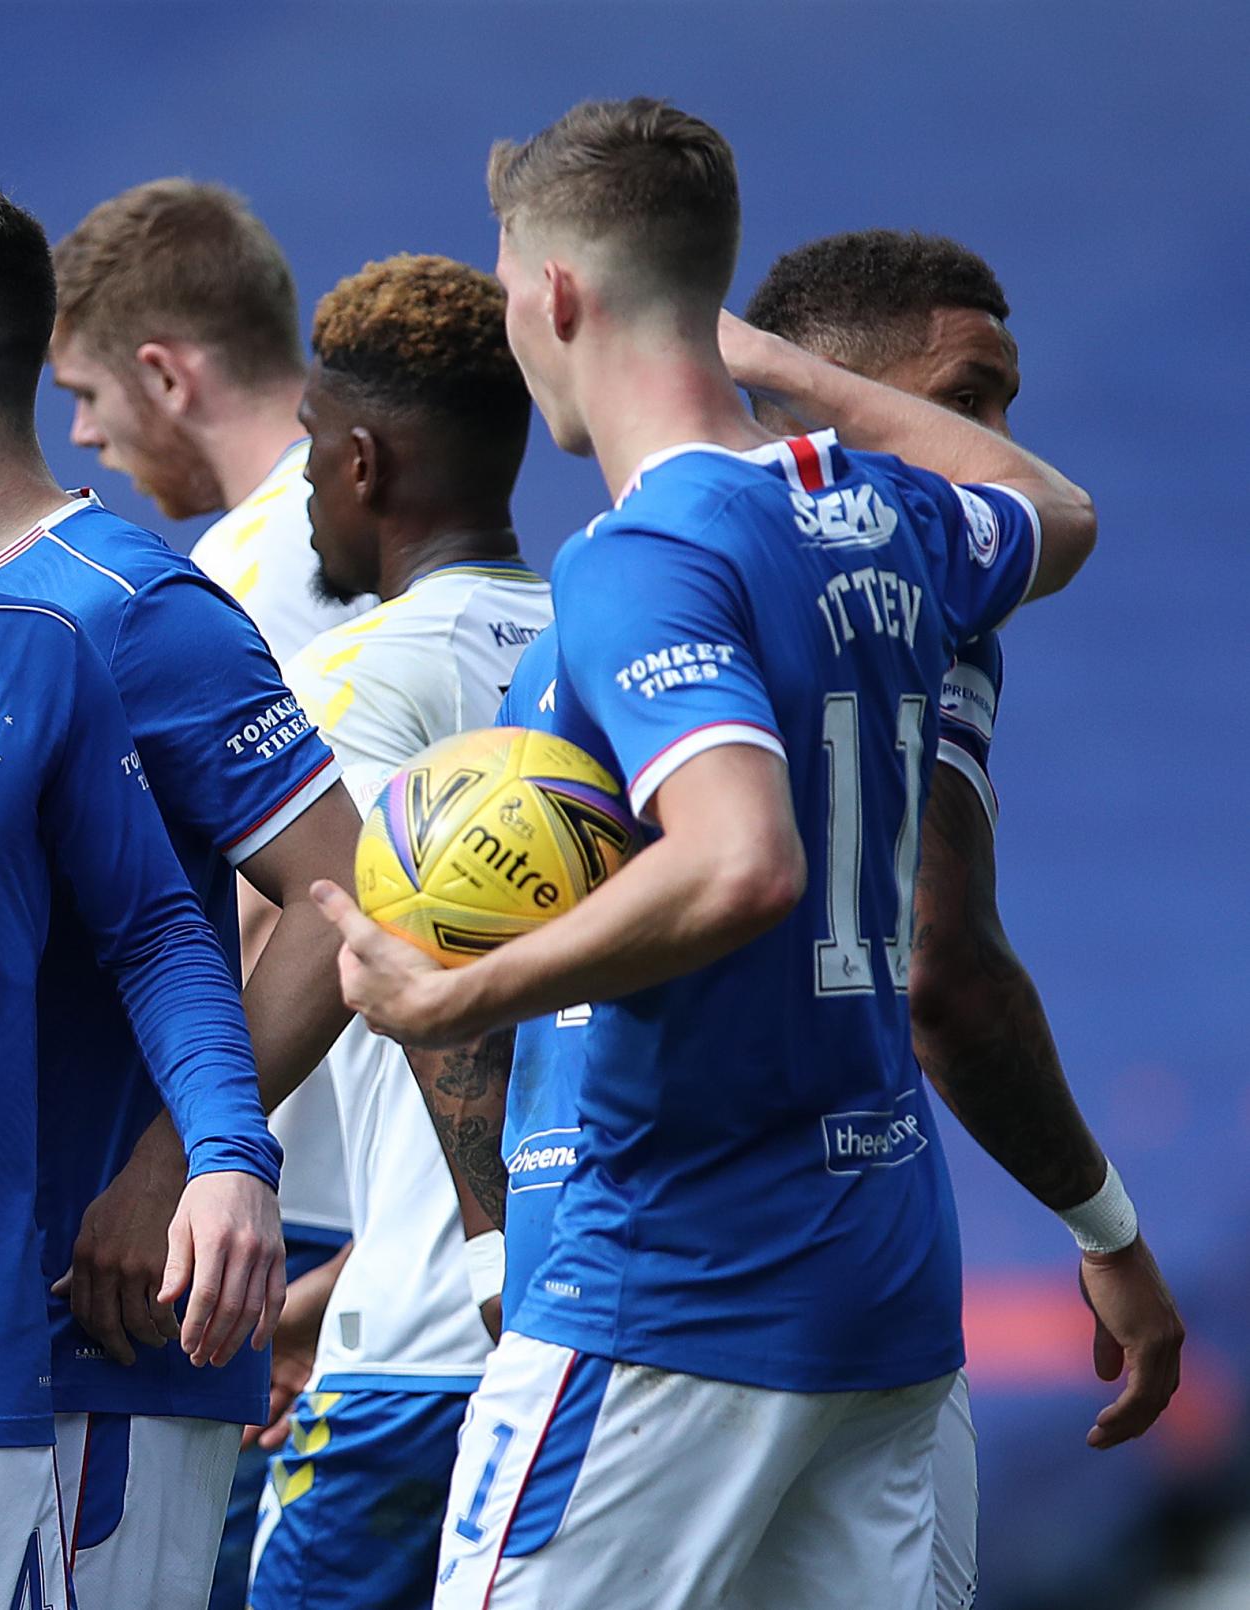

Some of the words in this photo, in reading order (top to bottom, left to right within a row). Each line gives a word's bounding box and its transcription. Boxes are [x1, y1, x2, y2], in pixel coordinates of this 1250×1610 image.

[817, 566, 923, 657] ITTEN
[615, 643, 735, 691] TOMKET
[639, 662, 719, 699] TIRES
[226, 695, 302, 755] TOMKE
[462, 825, 559, 908] mitre
[814, 691, 927, 996] 11
